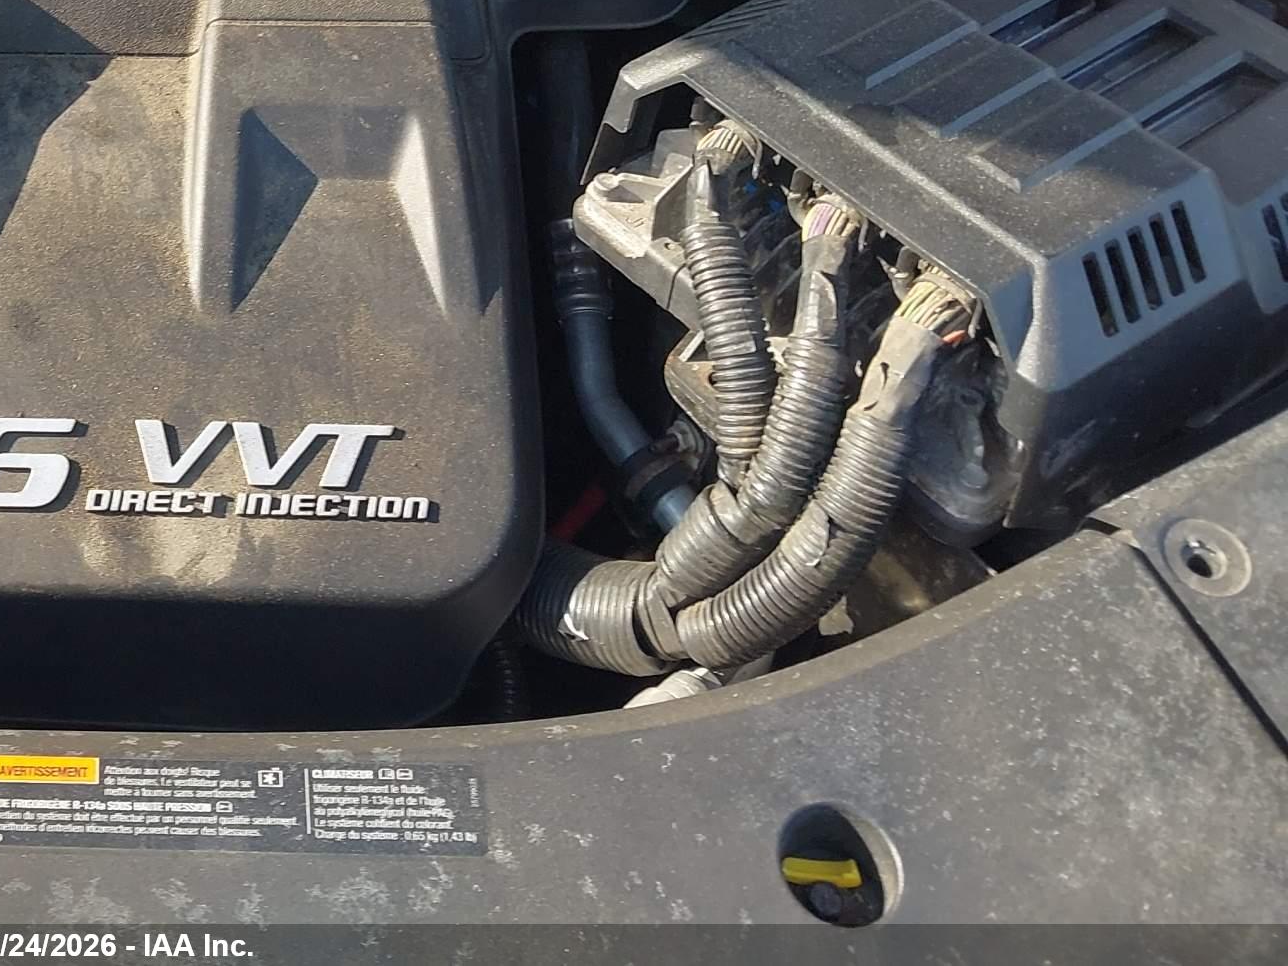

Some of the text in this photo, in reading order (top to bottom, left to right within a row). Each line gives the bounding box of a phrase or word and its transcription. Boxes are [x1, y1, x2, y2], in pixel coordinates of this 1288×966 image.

[135, 419, 397, 488] VVT
[85, 489, 431, 521] DIRECT INJECTION
[0, 765, 88, 778] AVERTISSEMENT
